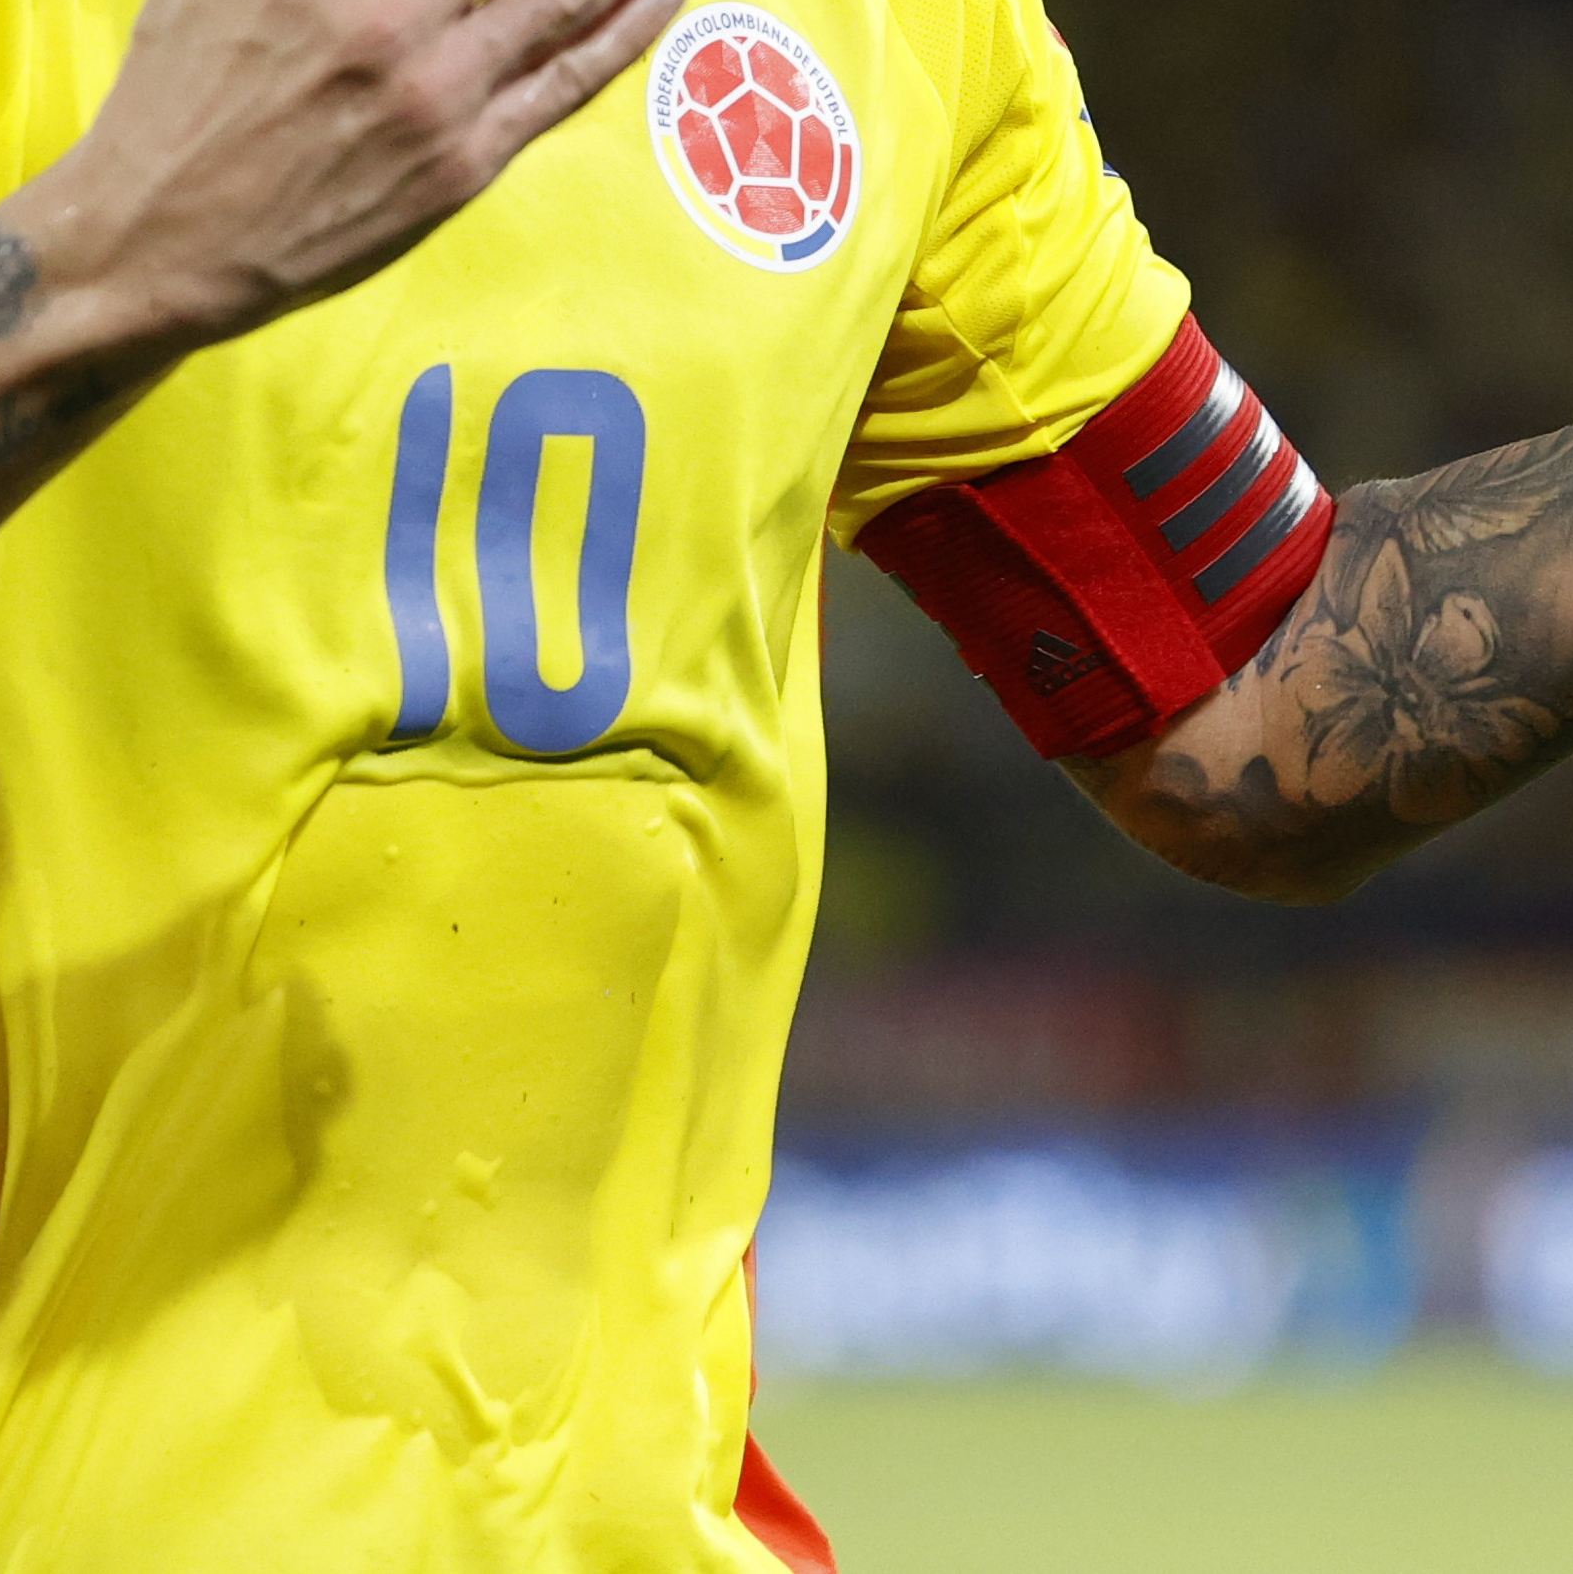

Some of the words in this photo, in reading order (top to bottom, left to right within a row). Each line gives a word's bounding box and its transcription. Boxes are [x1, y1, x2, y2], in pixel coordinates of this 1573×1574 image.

[695, 12, 790, 52] COLOMBIANA
[793, 44, 810, 68] DE
[385, 363, 646, 753] 10
